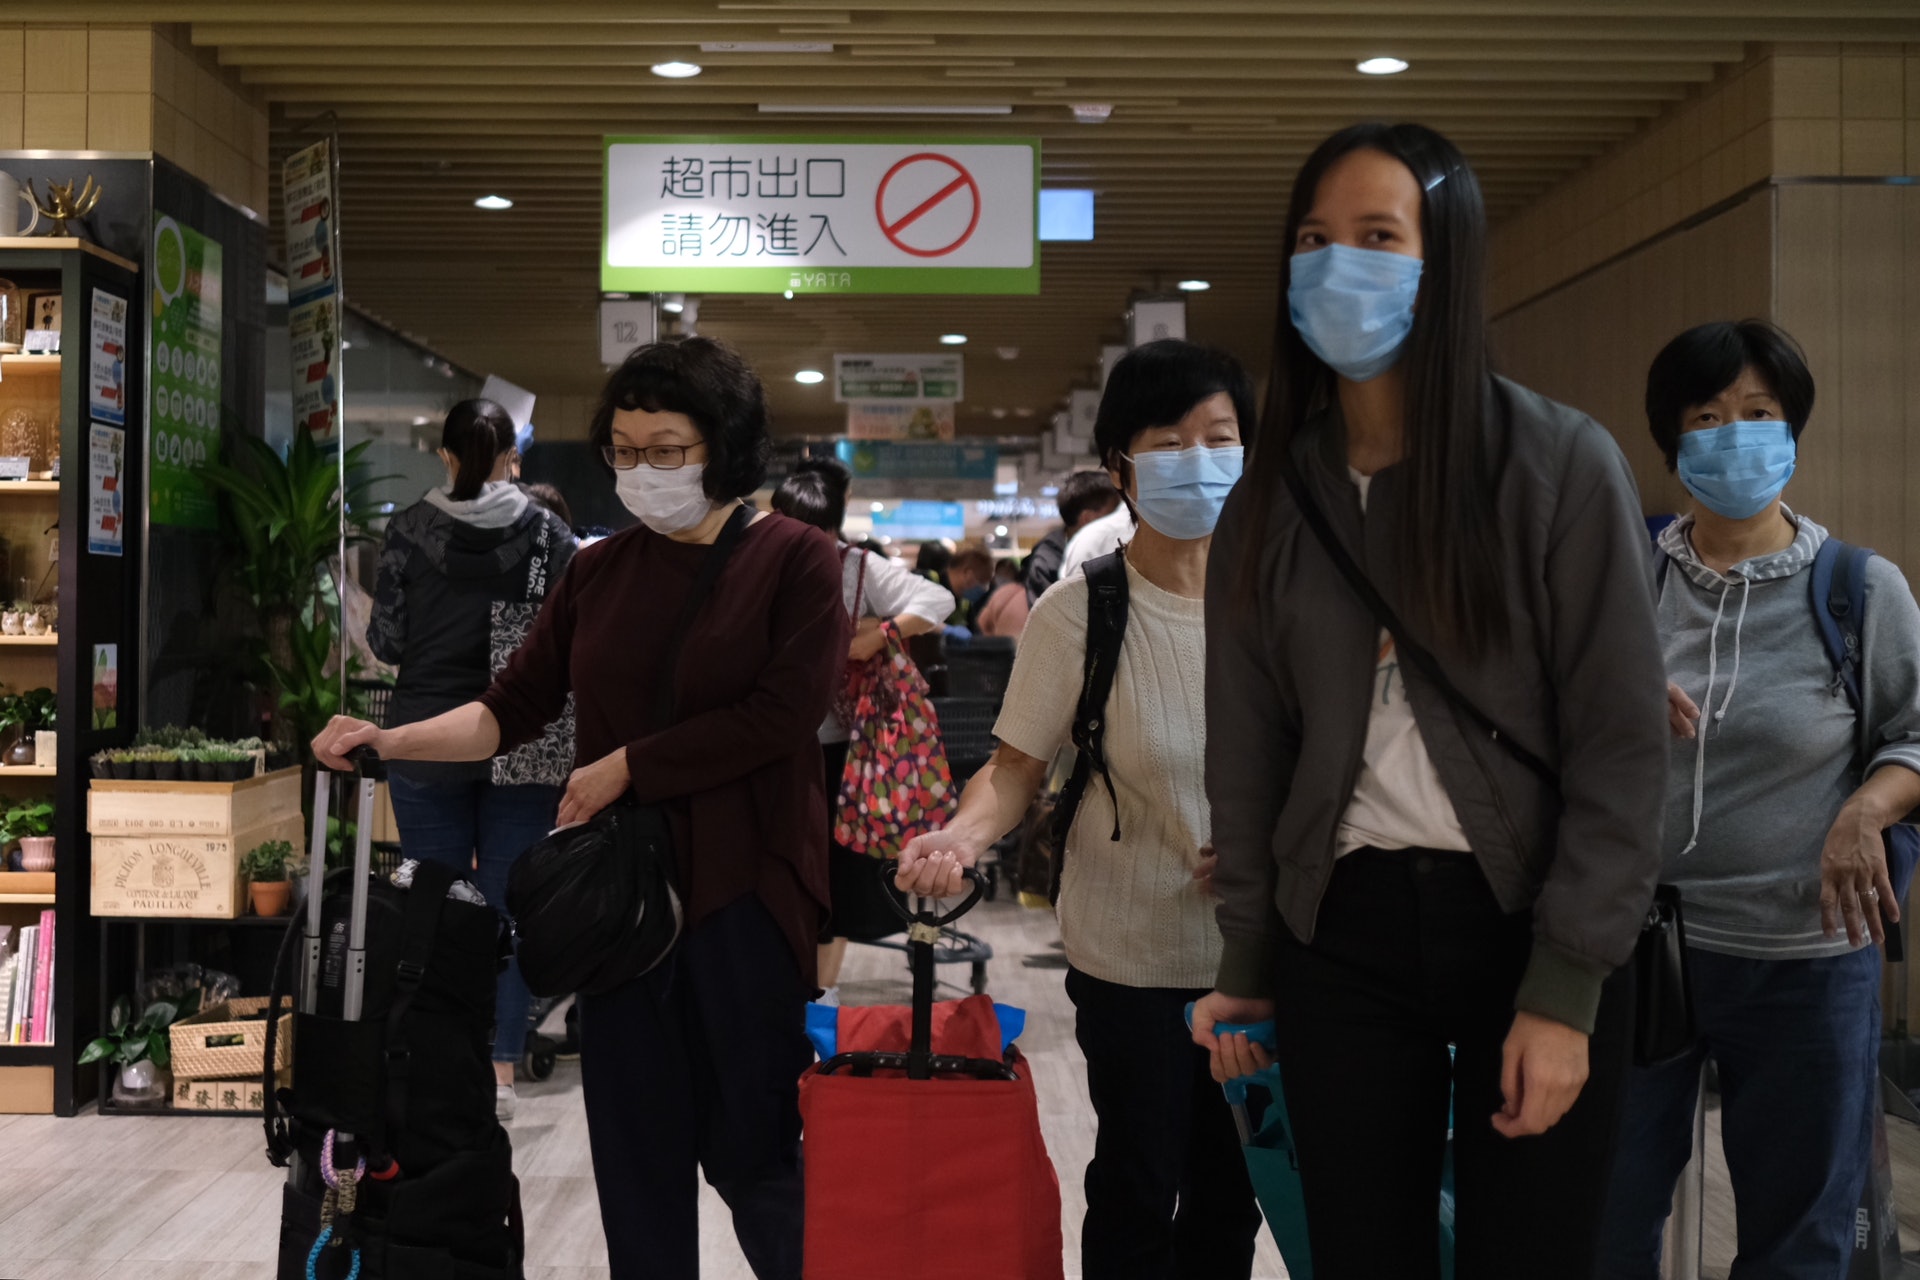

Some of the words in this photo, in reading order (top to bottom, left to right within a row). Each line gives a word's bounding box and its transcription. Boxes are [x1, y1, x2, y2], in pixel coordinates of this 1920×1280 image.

[661, 155, 846, 200] 超市出口
[661, 212, 848, 257] 請勿進入
[804, 272, 851, 287] YATA
[613, 320, 639, 344] 12
[114, 849, 144, 889] PICHON
[149, 842, 212, 890] LONGUEVILLE
[132, 900, 194, 910] PAUILLAC
